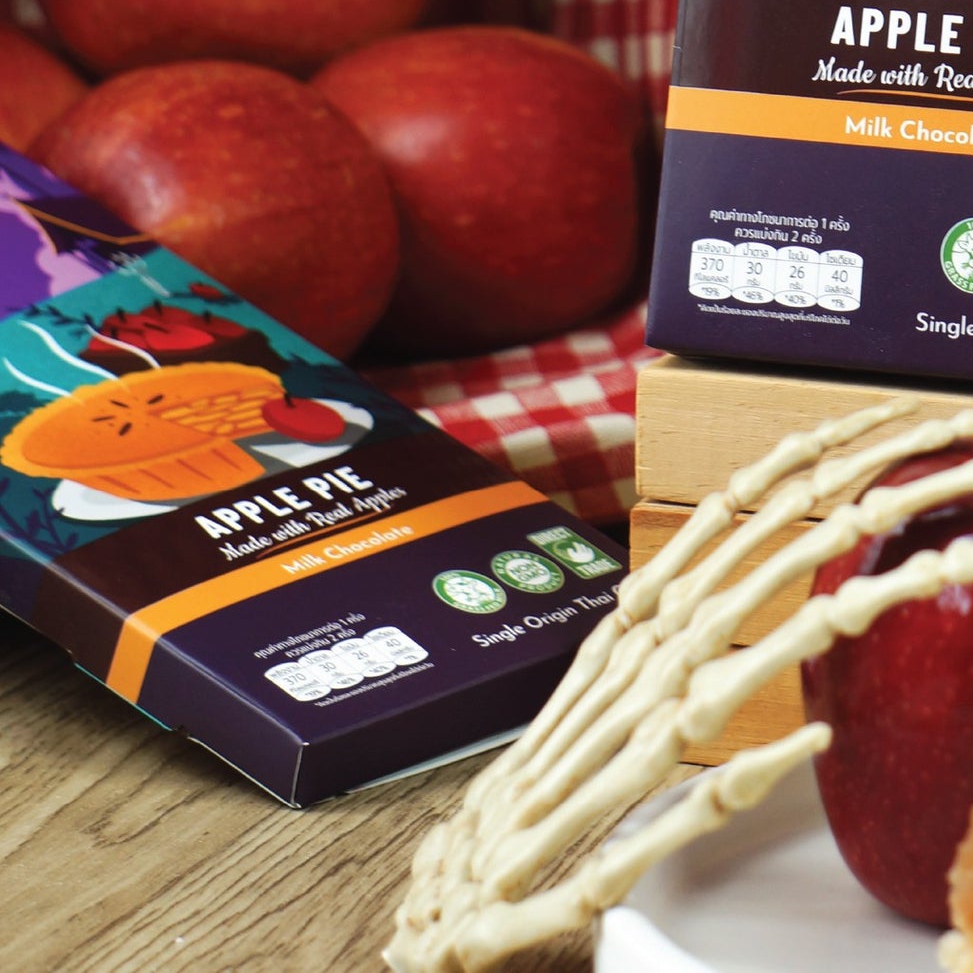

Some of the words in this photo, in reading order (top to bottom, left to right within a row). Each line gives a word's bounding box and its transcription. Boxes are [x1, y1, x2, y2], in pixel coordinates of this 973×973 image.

[830, 6, 964, 54] APPLE
[811, 56, 876, 84] Made
[880, 62, 928, 87] with
[845, 115, 892, 138] Milk
[821, 218, 827, 228] 1
[792, 231, 799, 241] 2
[701, 257, 724, 272] 370
[746, 261, 762, 275] 30
[789, 266, 805, 279] 26
[831, 270, 848, 283] 40
[945, 260, 968, 290] GRASS
[194, 486, 312, 540] APPLE
[302, 466, 374, 500] PIE
[219, 535, 273, 561] Made
[272, 519, 311, 542] with
[305, 503, 355, 527] Real
[352, 486, 407, 512] Apples
[281, 553, 326, 574] Milk
[323, 525, 414, 559] Chocolate
[471, 624, 526, 647] Single
[523, 606, 578, 629] Origin
[572, 591, 615, 610] Thai
[385, 638, 401, 648] 40
[352, 650, 369, 661] 26
[319, 661, 337, 672] 30
[283, 673, 307, 686] 370
